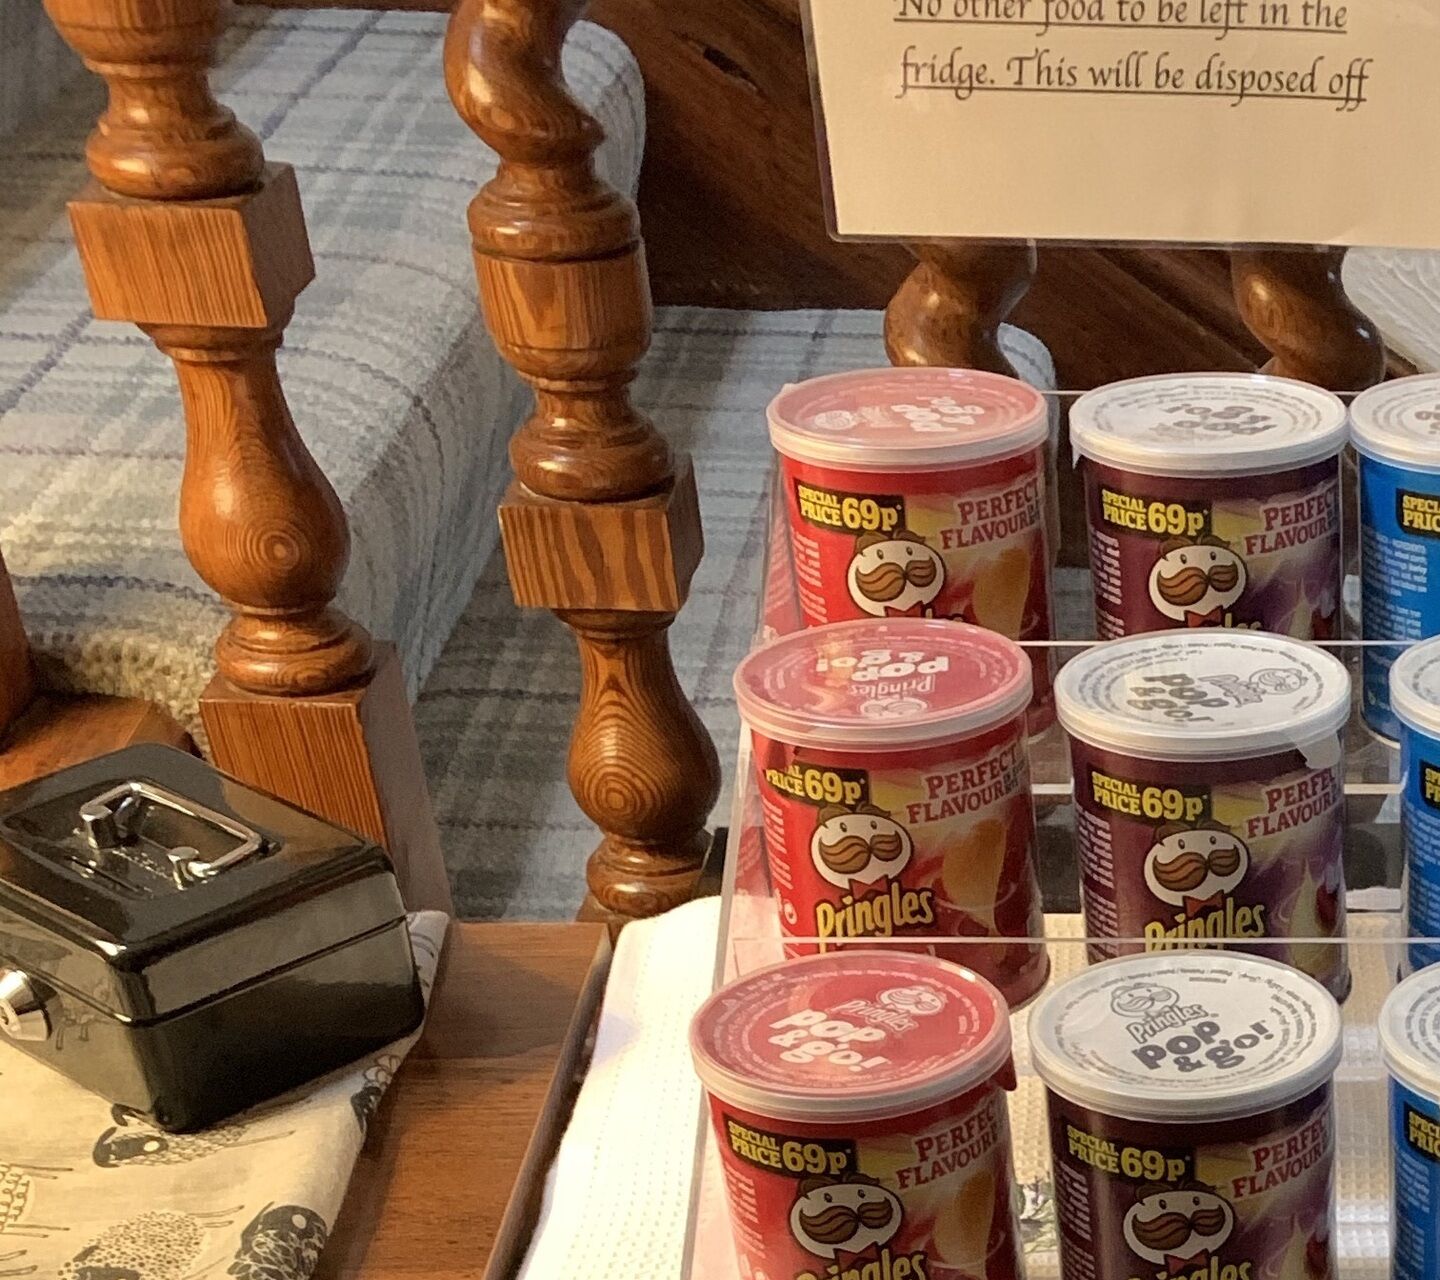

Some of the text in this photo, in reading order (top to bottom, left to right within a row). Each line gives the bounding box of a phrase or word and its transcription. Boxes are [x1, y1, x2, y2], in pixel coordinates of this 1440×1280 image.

[899, 0, 1347, 40] No other food to be left in the
[895, 45, 1375, 112] fridge. This will be disposed off
[798, 485, 841, 508] SPECIAL
[957, 477, 1039, 526] PERFECT
[1102, 489, 1146, 512] SPECIAL
[801, 502, 843, 526] PRICE
[1103, 504, 1147, 531] PRICE
[925, 745, 1018, 799] PERFECT
[1092, 771, 1141, 797] SPECIAL
[906, 781, 1006, 824] FLAVOUR
[1093, 788, 1141, 815] PRICE
[816, 883, 934, 954] Pringles
[1145, 898, 1265, 953] Pringles
[1127, 1004, 1209, 1044] Pringles
[728, 1120, 780, 1149] SPECIAL
[1067, 1125, 1119, 1156] SPECIAL
[731, 1136, 782, 1168] PRICE
[1069, 1139, 1120, 1174] PRICE
